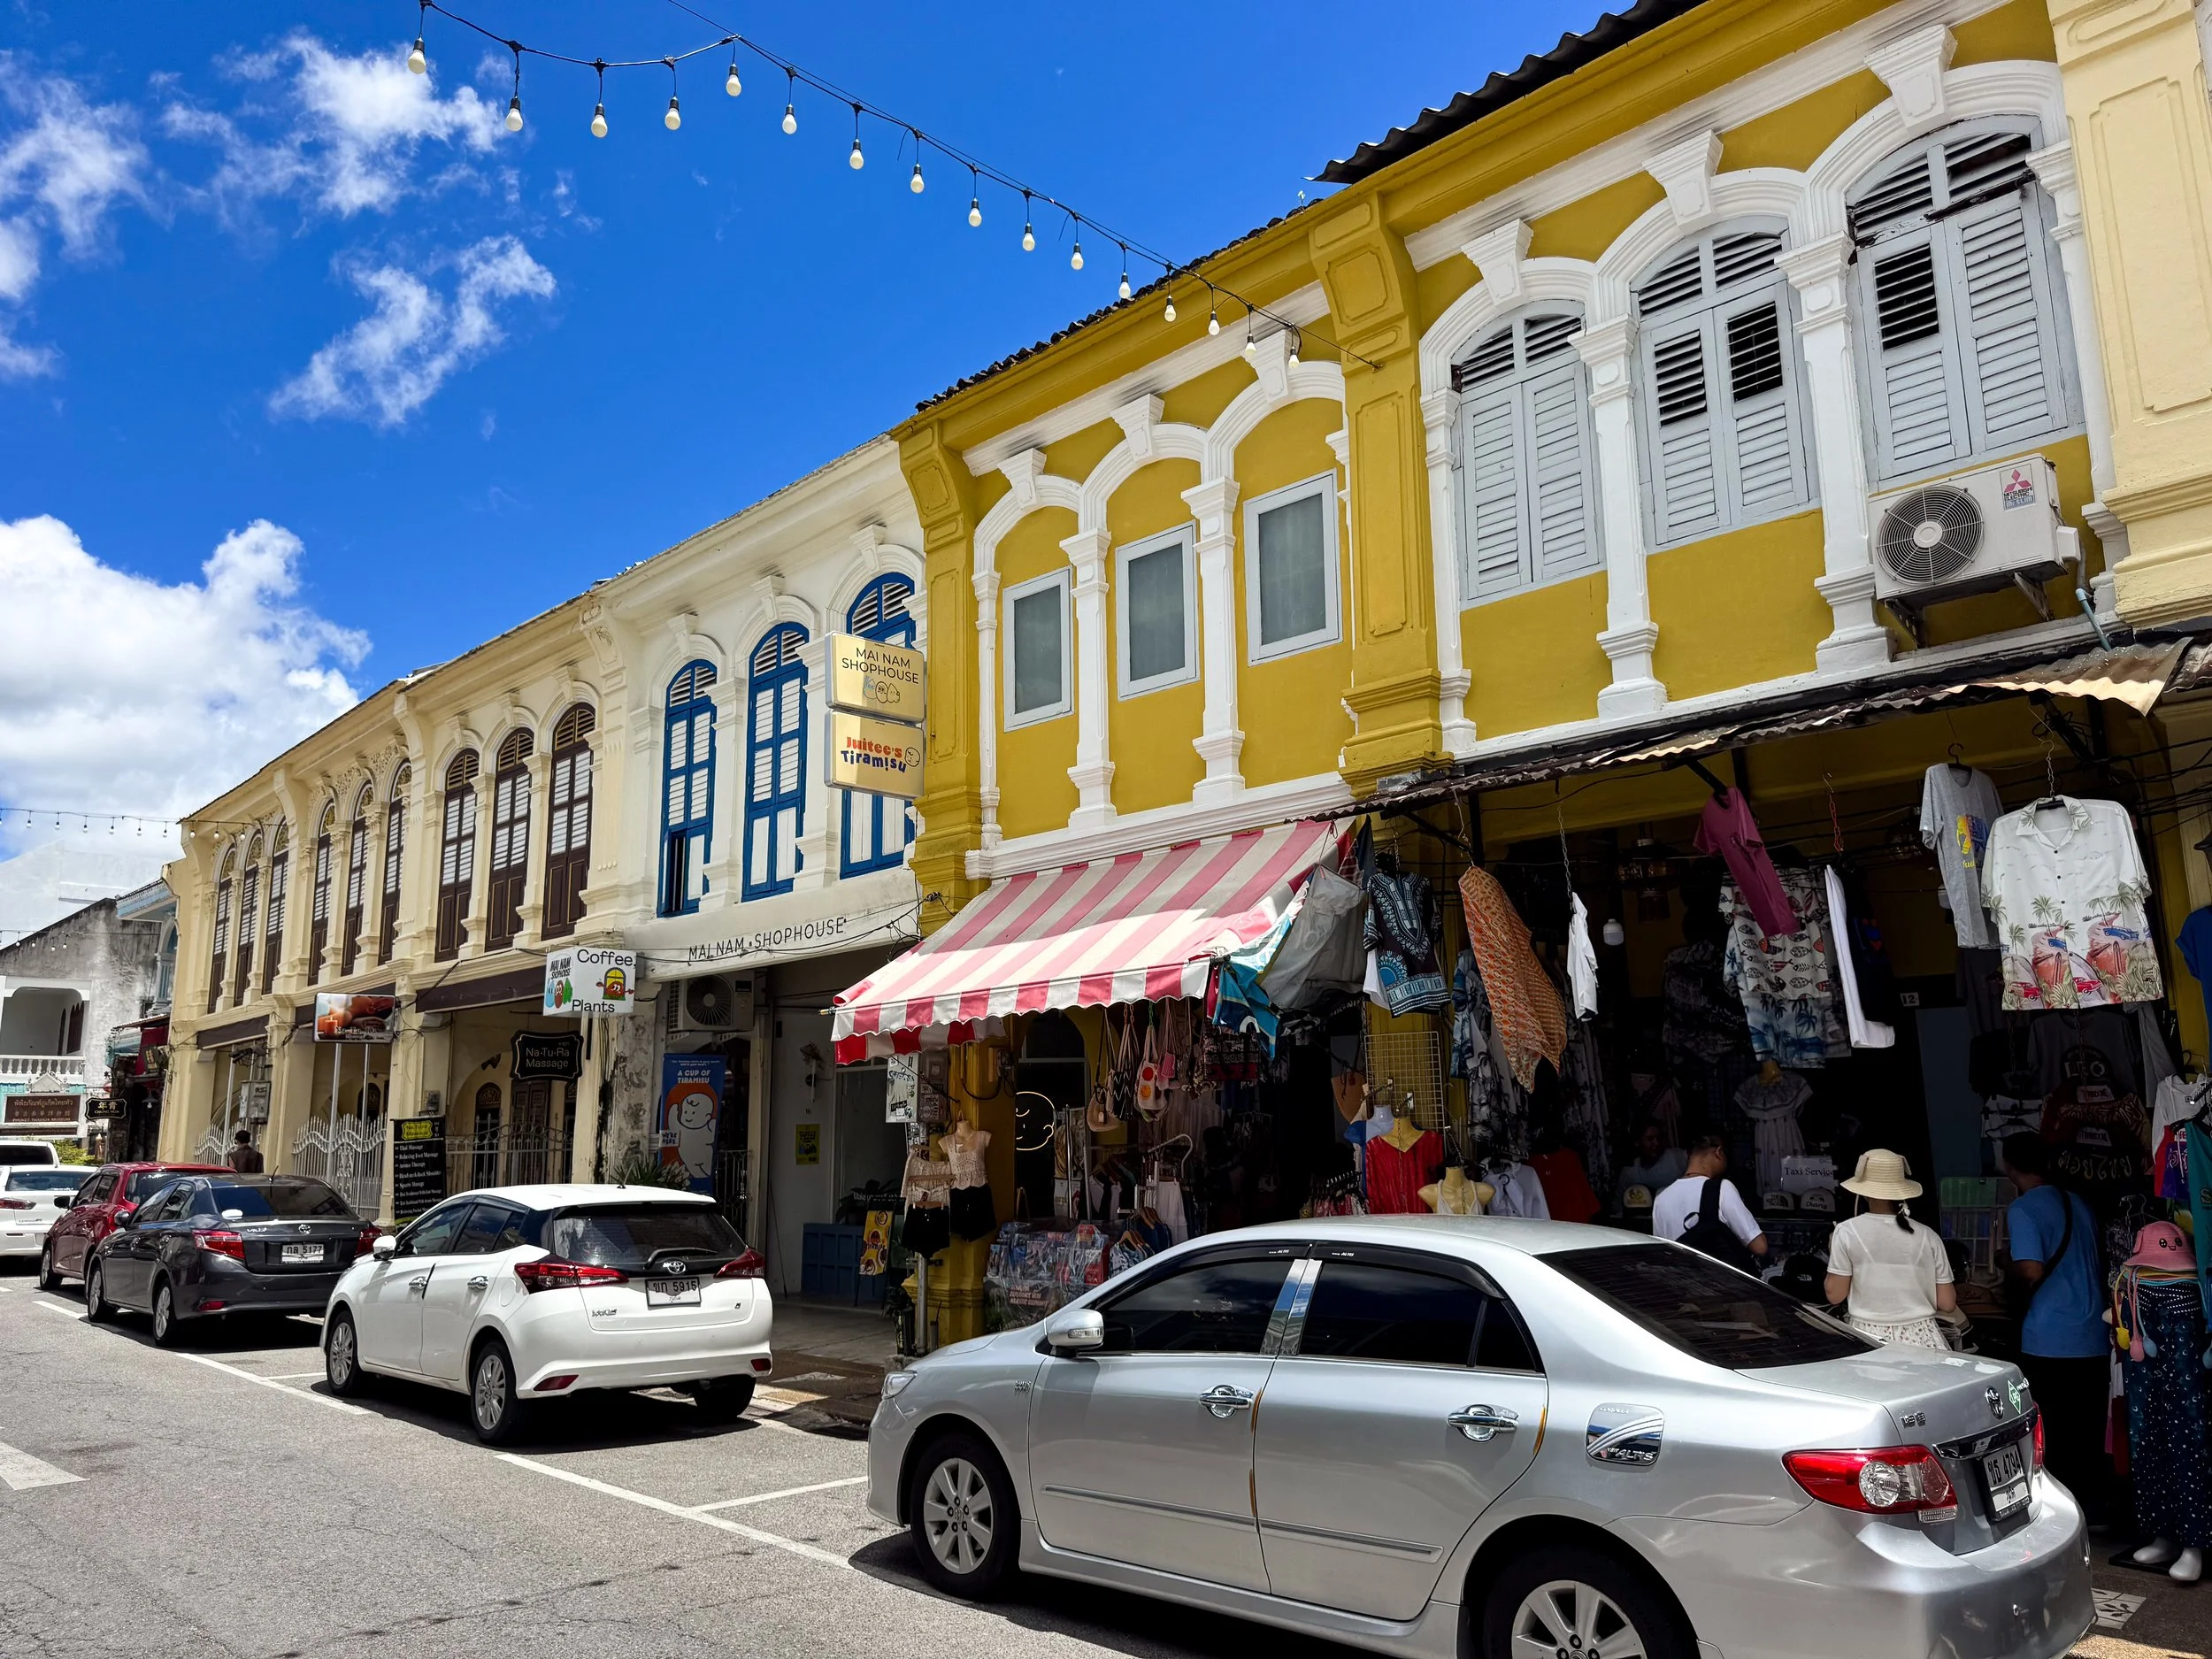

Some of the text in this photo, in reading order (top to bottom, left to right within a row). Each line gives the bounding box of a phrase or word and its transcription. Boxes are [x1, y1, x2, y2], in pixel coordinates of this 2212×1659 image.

[856, 647, 910, 669] MAI NAM
[841, 657, 919, 684] SHOPHOUSE
[688, 917, 844, 961] MAI NAM SHOPHOUSE
[572, 999, 615, 1013] Plants
[526, 1058, 568, 1070] Massage
[1805, 1167, 1833, 1176] Service
[673, 1280, 697, 1292] 5915
[2002, 1450, 2022, 1479] 4794
